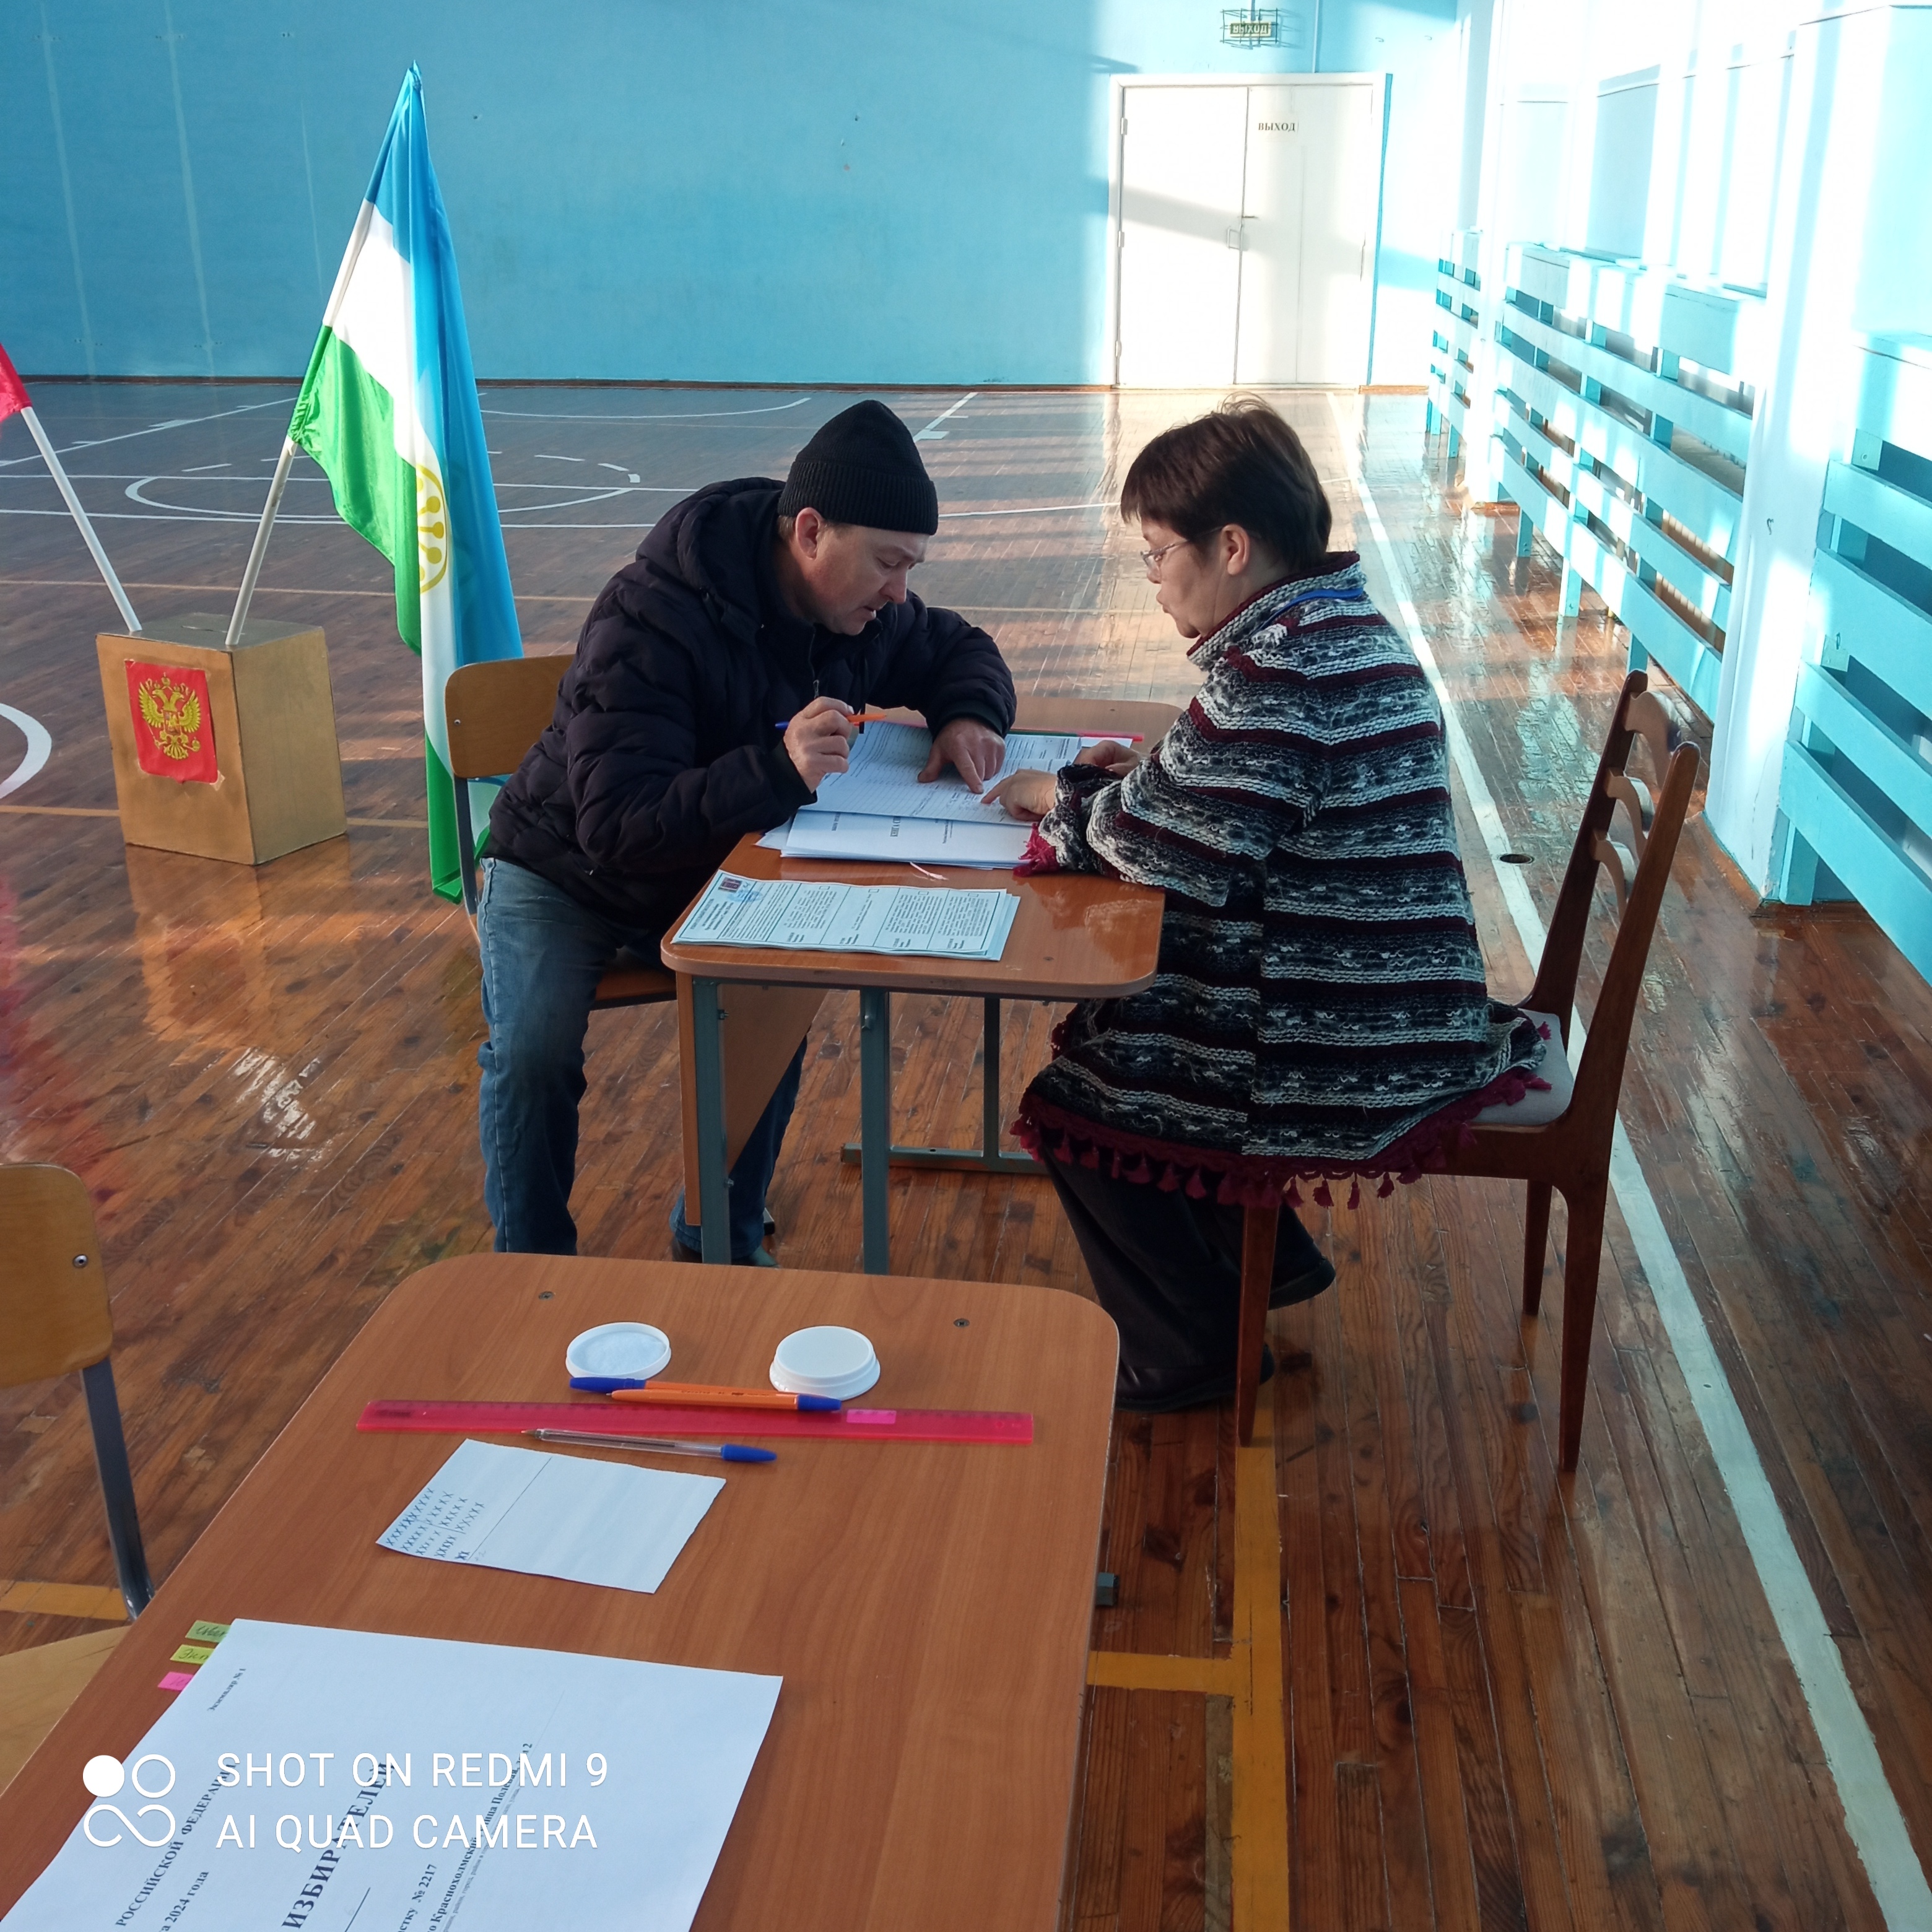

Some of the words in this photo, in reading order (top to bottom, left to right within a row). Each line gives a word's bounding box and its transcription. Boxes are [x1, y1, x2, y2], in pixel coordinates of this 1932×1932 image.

[1233, 25, 1268, 33] ВЫХОД
[1258, 122, 1295, 132] ВЫХОД
[115, 1840, 184, 1926] РОССИЙСКОЙ
[165, 1898, 190, 1923] 2024
[187, 1871, 209, 1897] года
[398, 1907, 418, 1932] стку
[411, 1889, 425, 1903] №
[418, 1864, 437, 1888] 2217
